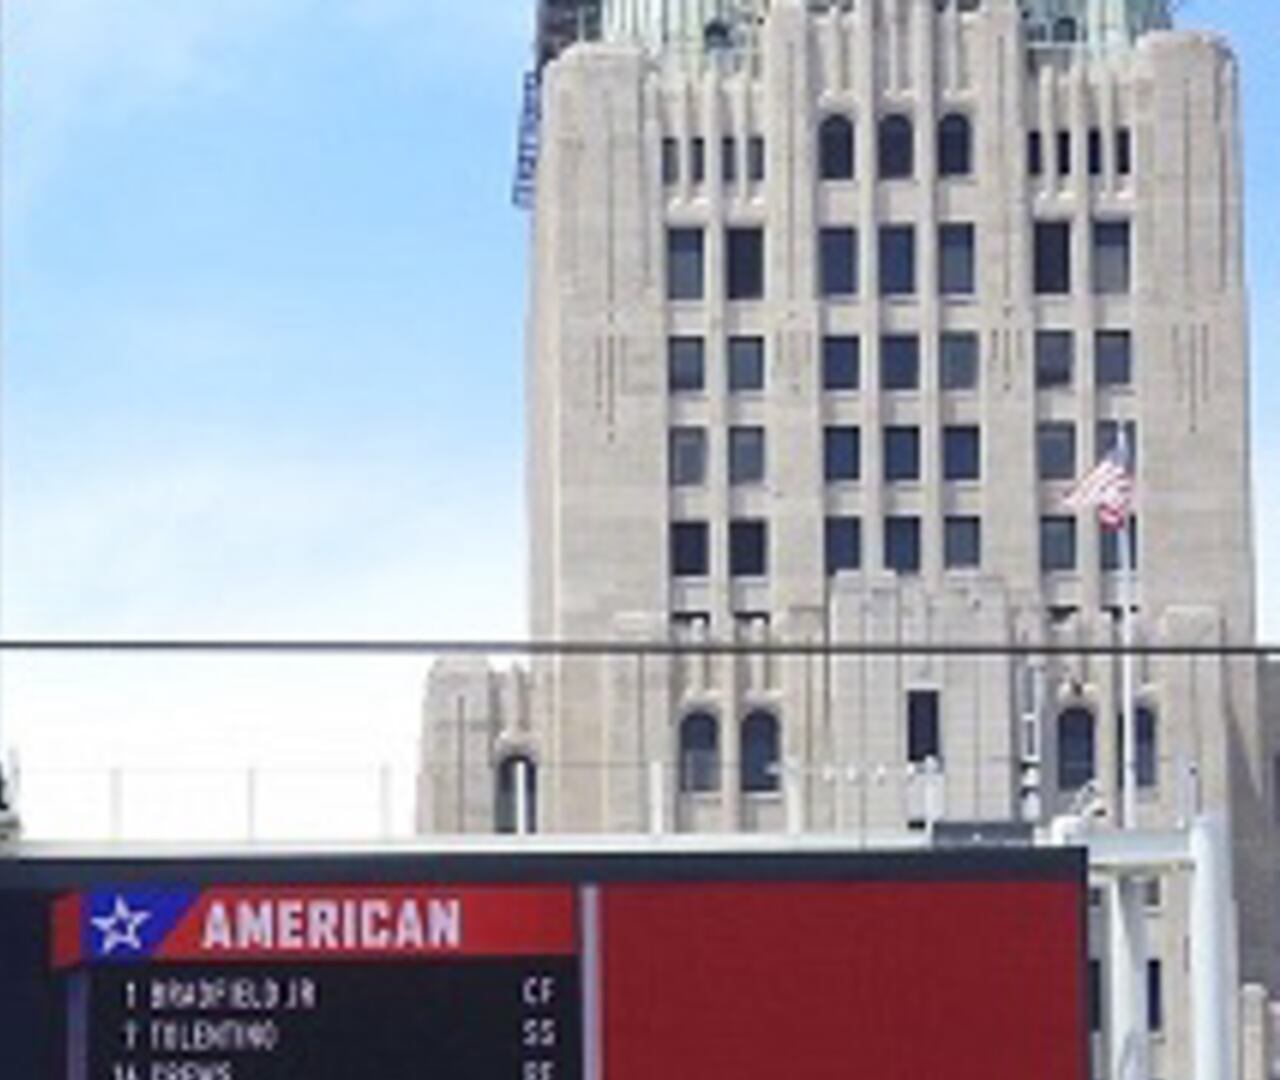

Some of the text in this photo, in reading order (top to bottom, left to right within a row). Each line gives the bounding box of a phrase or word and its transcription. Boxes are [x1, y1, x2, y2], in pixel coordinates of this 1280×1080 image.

[202, 898, 462, 950] AMERICAN
[522, 977, 555, 1003] CF
[523, 1019, 555, 1046] SS
